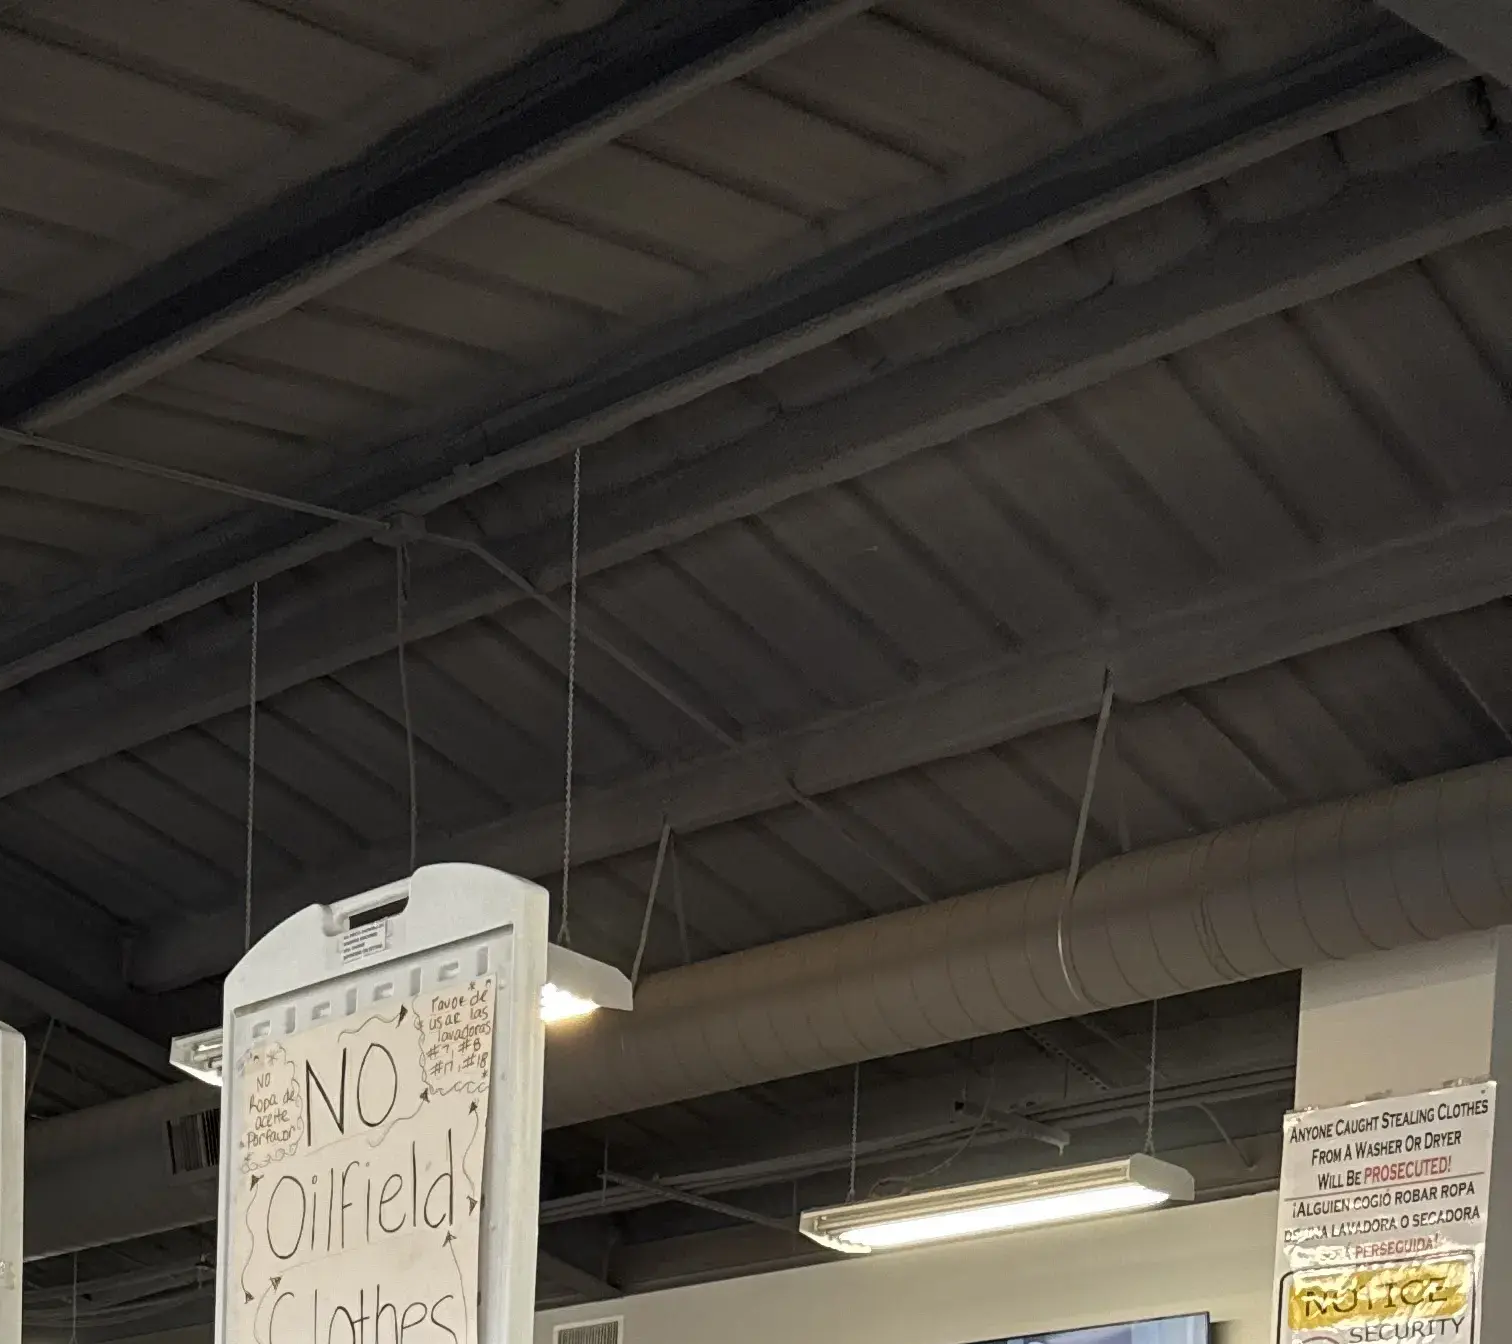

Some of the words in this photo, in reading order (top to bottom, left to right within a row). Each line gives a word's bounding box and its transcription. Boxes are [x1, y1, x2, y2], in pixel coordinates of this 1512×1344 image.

[470, 989, 488, 1006] de
[470, 1006, 488, 1020] las
[438, 1021, 491, 1042] lavadoras
[462, 1052, 488, 1070] #18
[256, 1072, 271, 1093] NO
[305, 1042, 398, 1147] NO
[1289, 1122, 1333, 1144] ANYONE
[1335, 1114, 1379, 1138] CAUGHT
[1381, 1108, 1435, 1130] STEALING
[1437, 1099, 1489, 1122] CLOTHES
[1311, 1147, 1342, 1167] FROM
[1344, 1144, 1353, 1160] A
[1355, 1137, 1402, 1160] WASHER
[1424, 1130, 1461, 1150] DRYER
[1317, 1171, 1344, 1191] WILL
[1346, 1168, 1361, 1187] BE
[1364, 1155, 1452, 1185] PROSECUTED!
[266, 1127, 454, 1260] Oilfield
[1291, 1198, 1350, 1219] ¡ALGUIEN
[1394, 1187, 1438, 1206] ROBAR
[1440, 1181, 1475, 1200] ROPA
[1331, 1218, 1397, 1238] LAVADORA
[1400, 1214, 1409, 1228] O
[1412, 1205, 1480, 1227] SECADORA
[1355, 1230, 1440, 1259] PERSEGUIDA!
[1305, 1277, 1448, 1317] NOTICE
[1348, 1316, 1465, 1344] SECURITY
